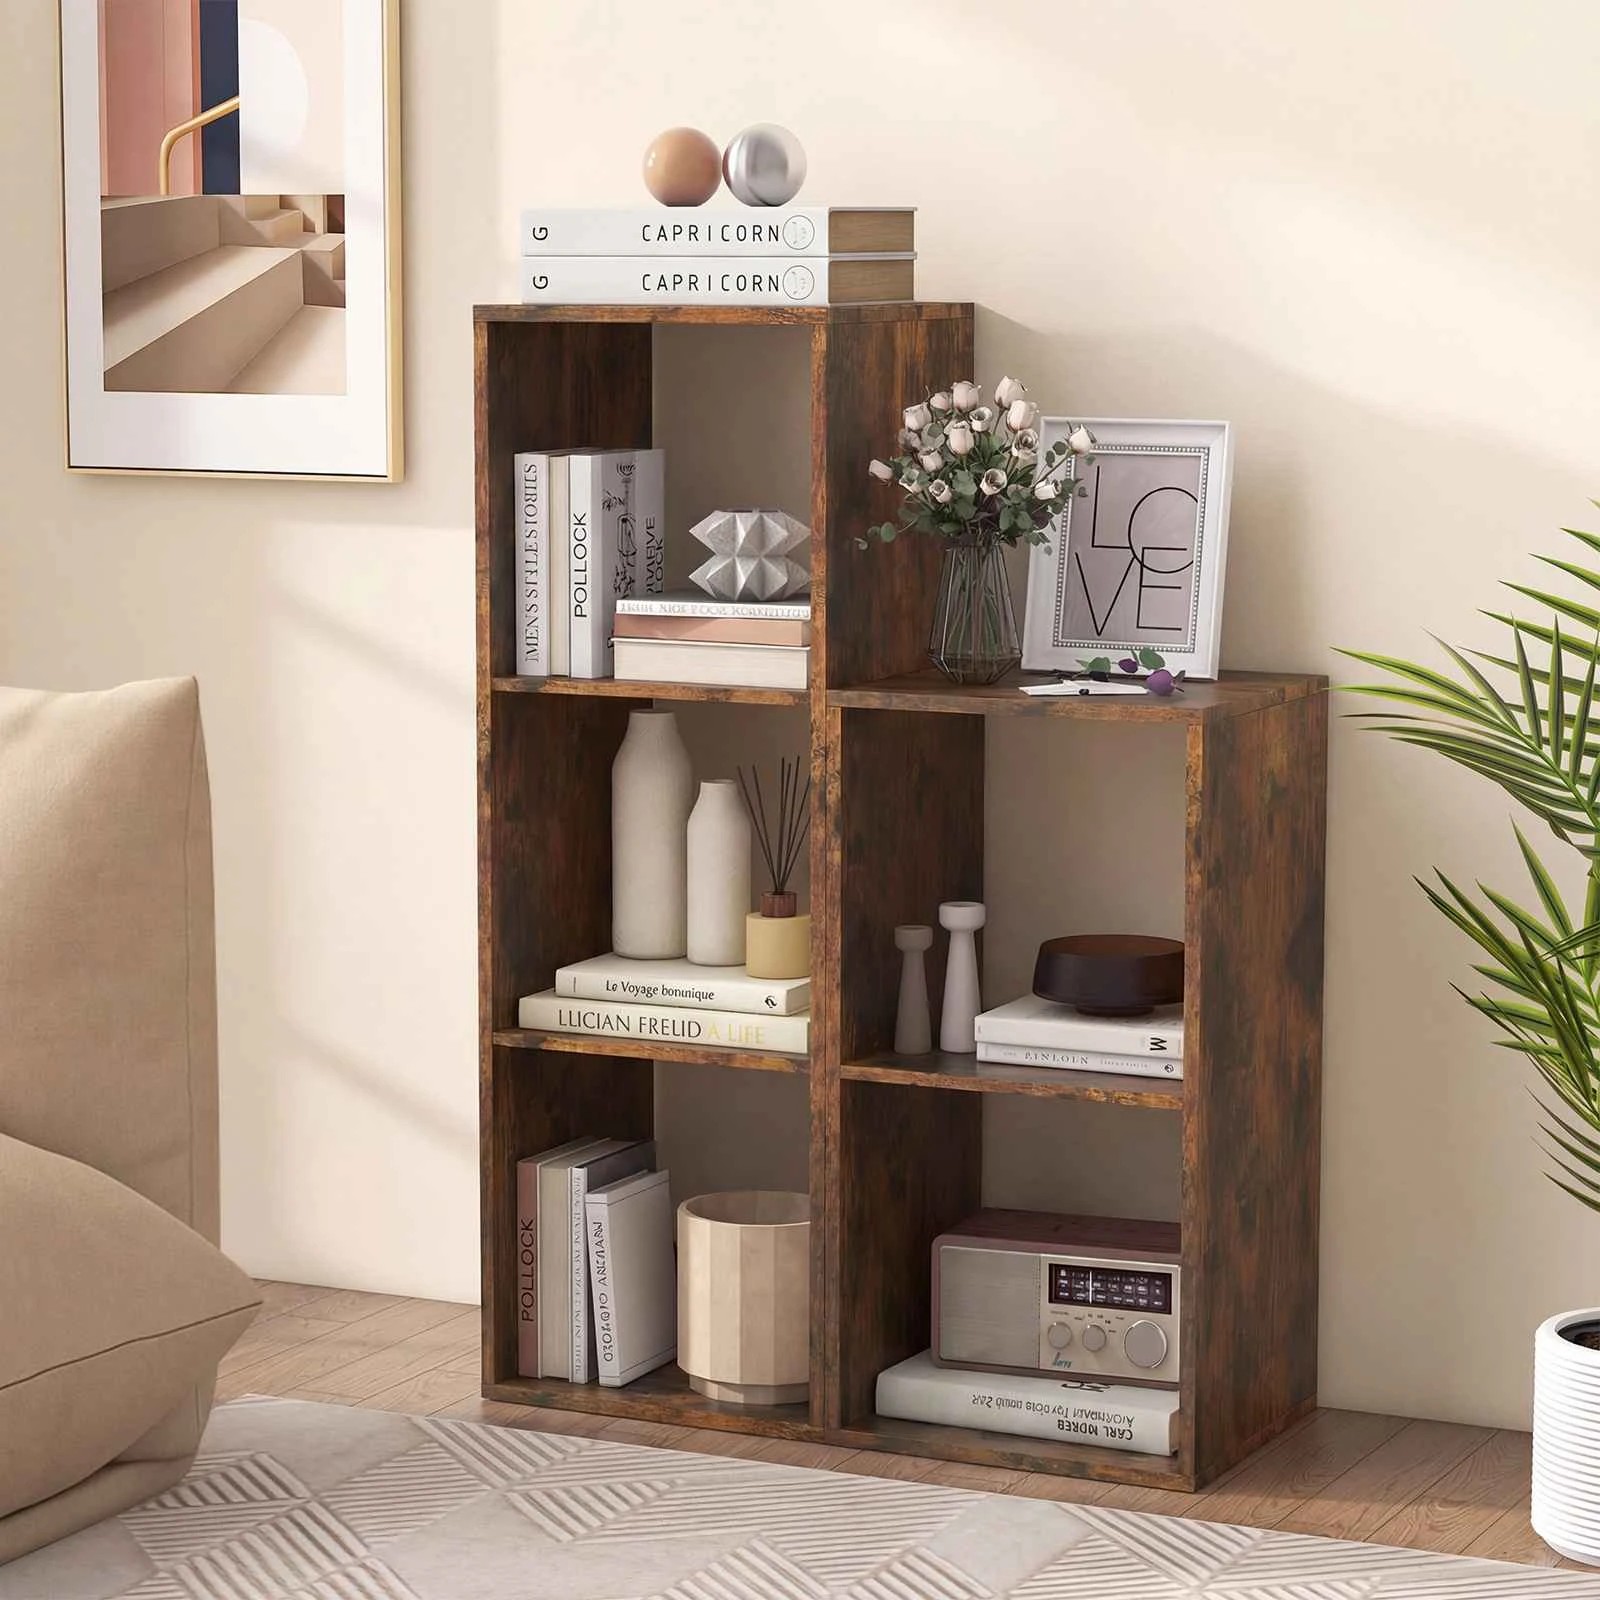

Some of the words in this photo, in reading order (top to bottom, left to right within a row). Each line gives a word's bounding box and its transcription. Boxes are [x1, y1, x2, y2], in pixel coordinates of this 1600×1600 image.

[532, 226, 549, 241] G
[641, 224, 780, 242] CAPRICORN
[532, 275, 549, 290] G
[641, 273, 780, 292] CAPRICORN
[573, 511, 588, 618] POLLOCK
[621, 981, 659, 998] Voyage
[520, 1218, 534, 1322] POLLOCK
